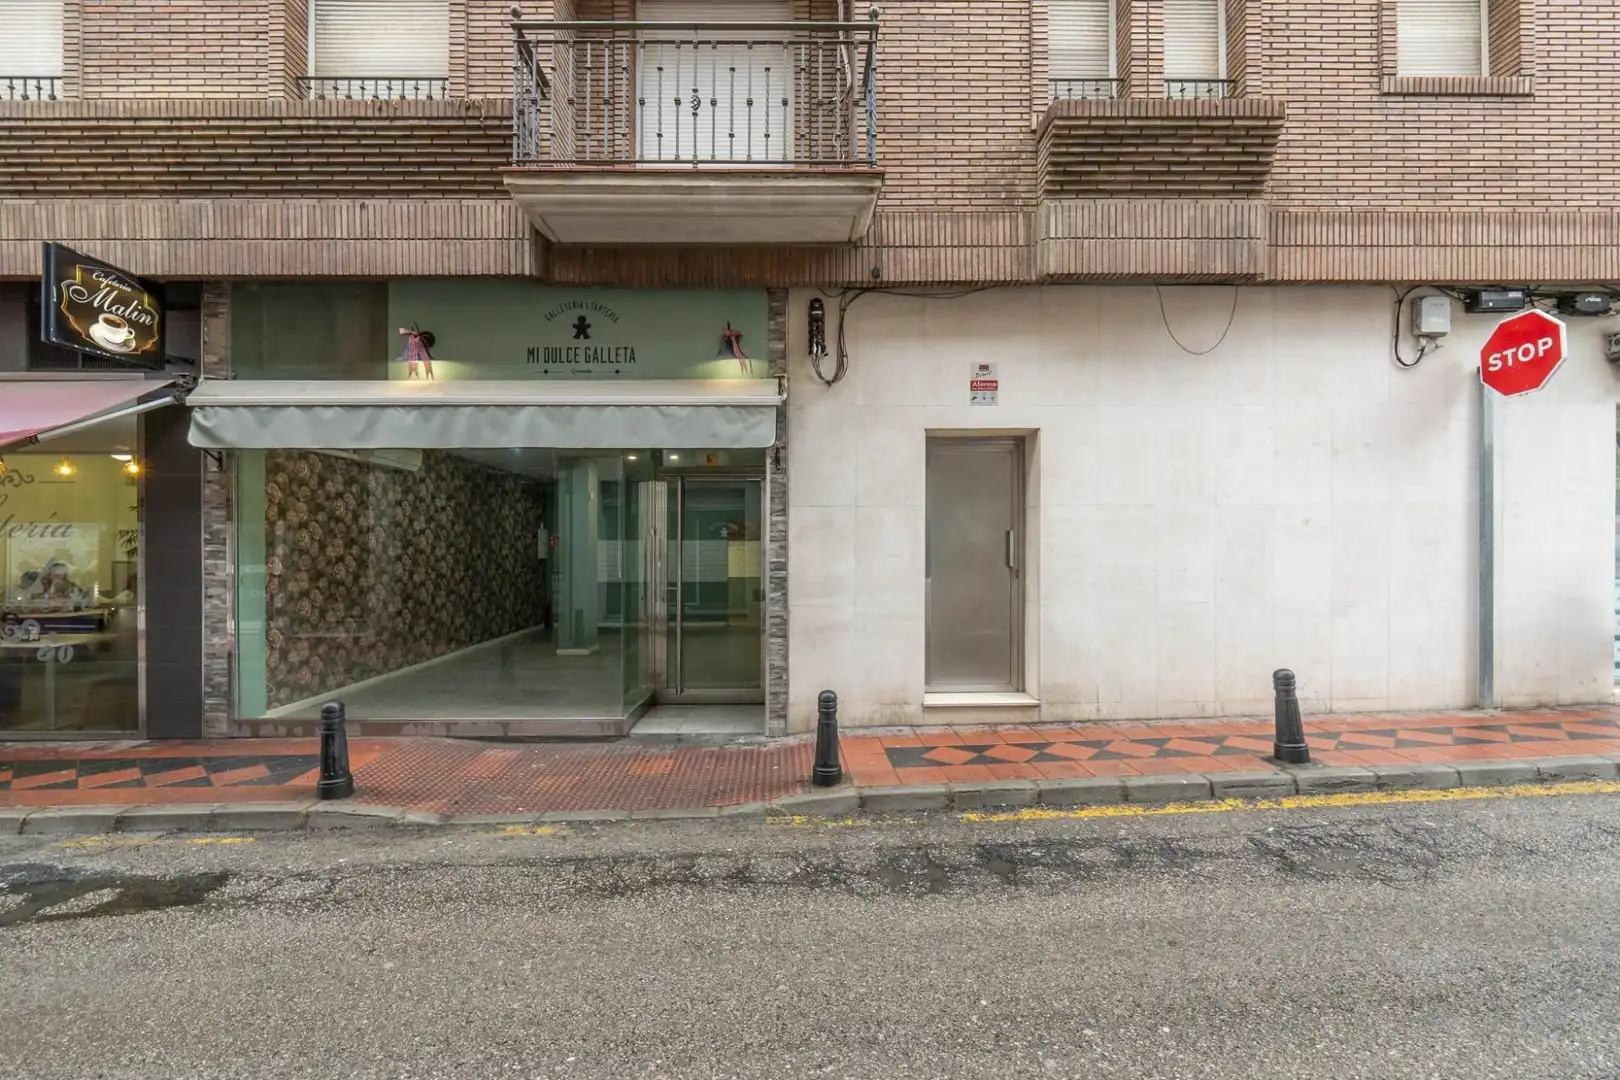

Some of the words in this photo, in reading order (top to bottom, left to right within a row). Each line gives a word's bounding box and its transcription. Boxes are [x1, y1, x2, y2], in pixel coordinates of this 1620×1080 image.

[69, 285, 153, 326] Malin
[527, 346, 540, 364] MI
[543, 346, 580, 364] DULCE
[584, 346, 636, 364] GALLETA
[1488, 337, 1553, 372] STOP
